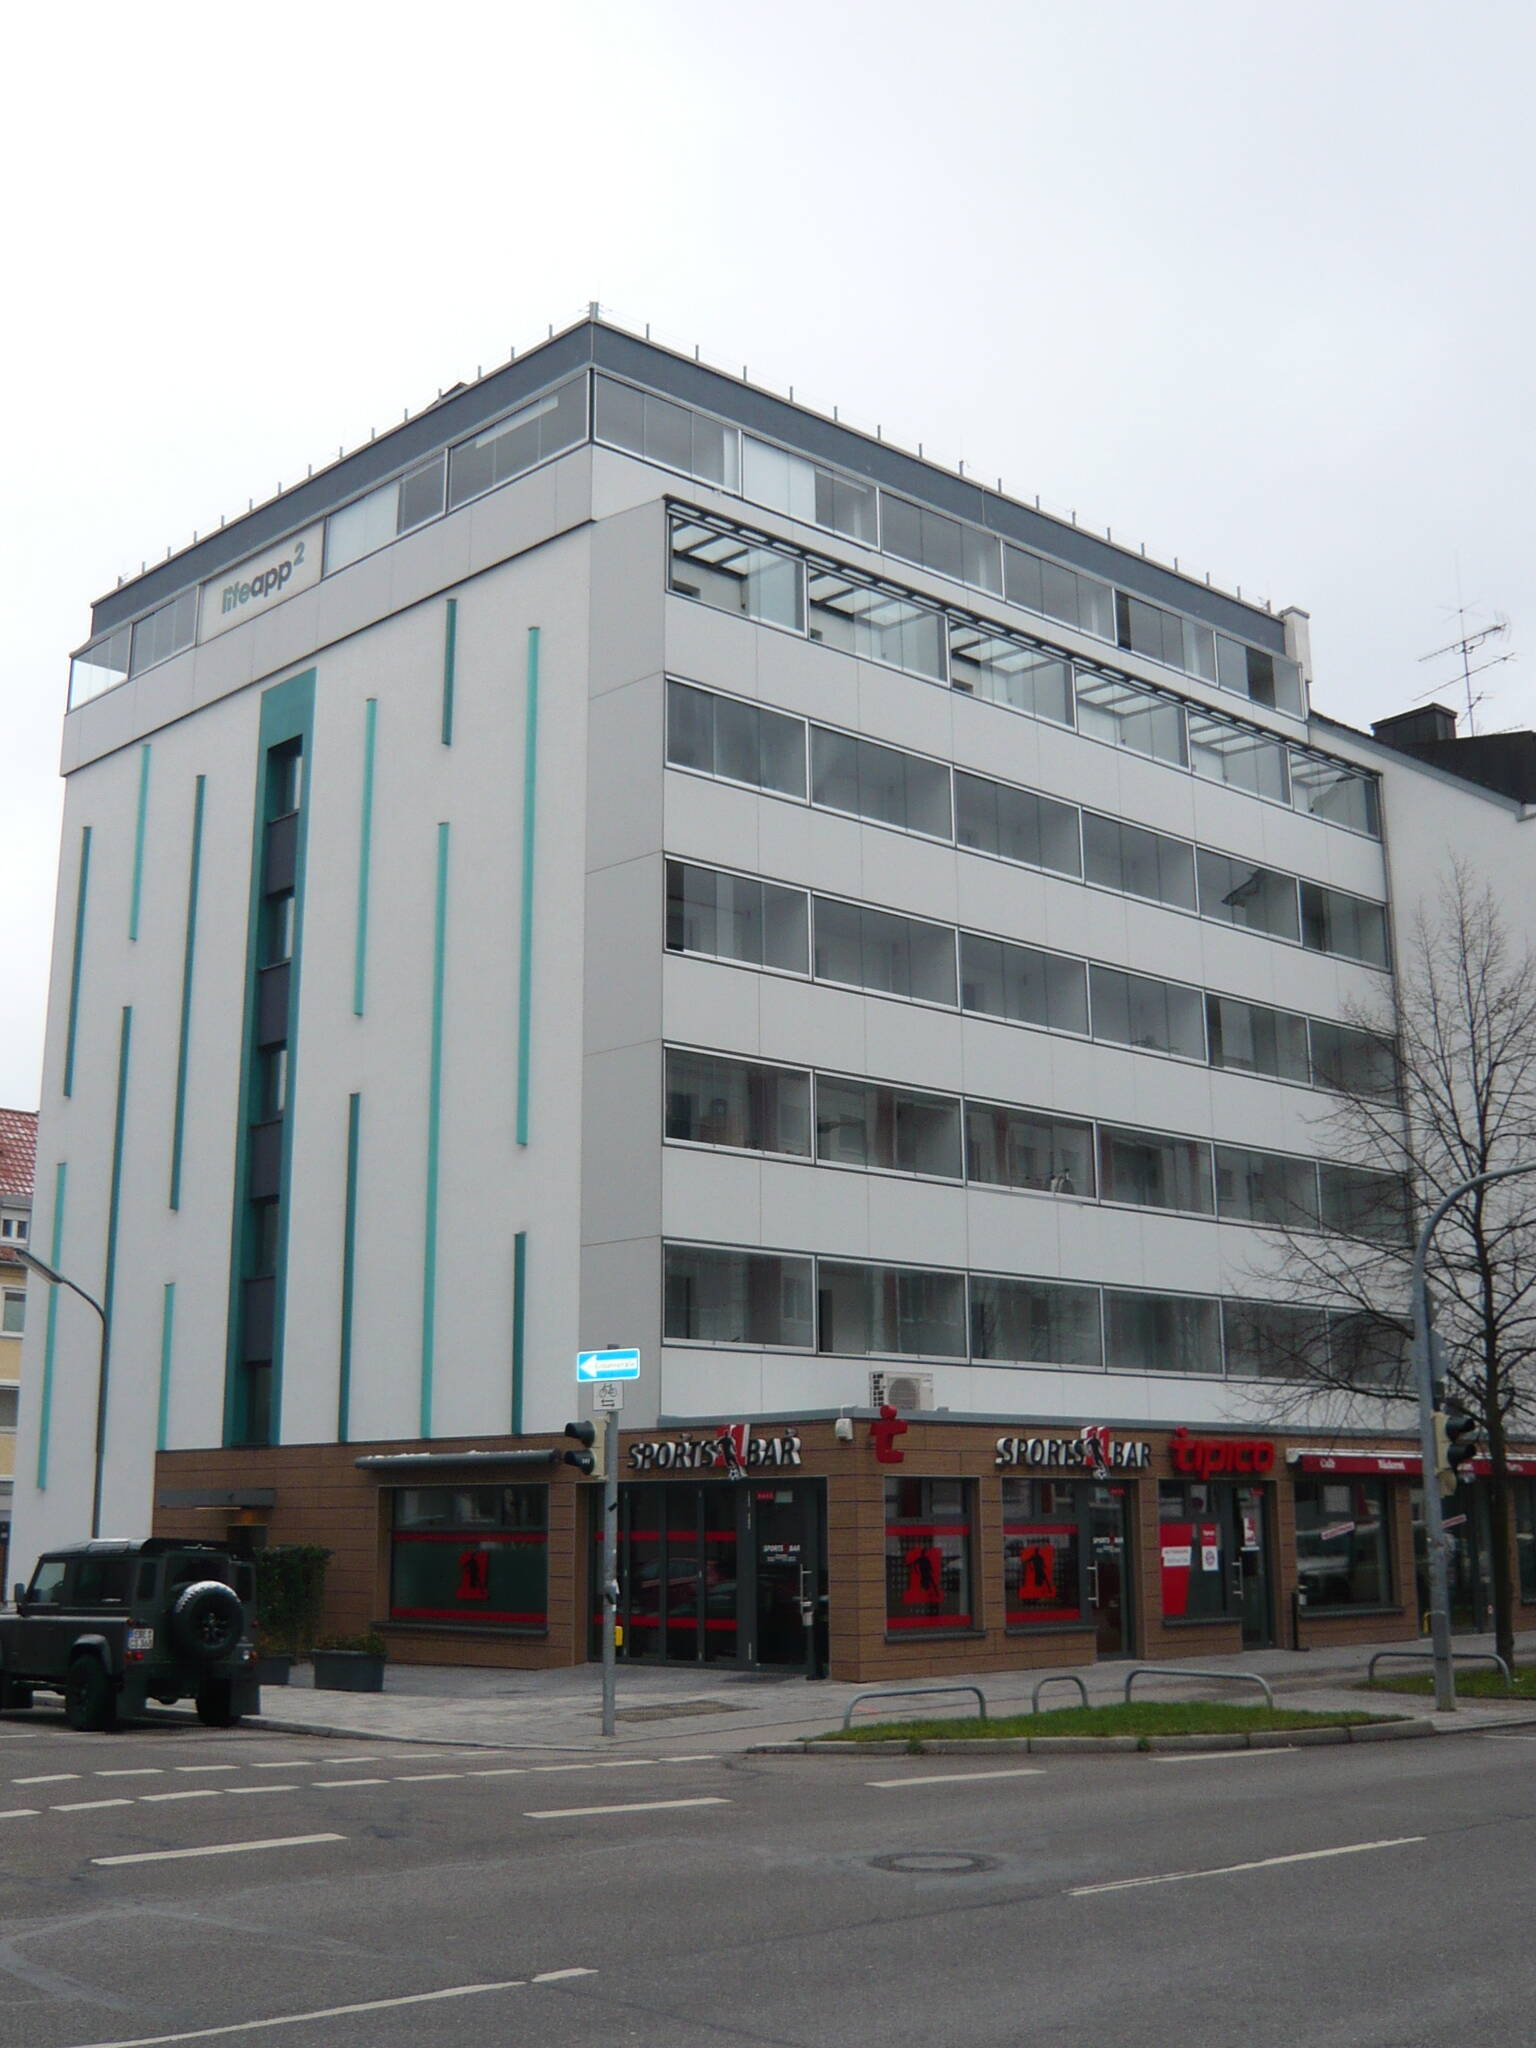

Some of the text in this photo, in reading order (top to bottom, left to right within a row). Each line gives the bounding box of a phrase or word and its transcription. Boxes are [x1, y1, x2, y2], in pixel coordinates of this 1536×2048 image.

[627, 1440, 719, 1470] SPORTS
[749, 1437, 802, 1467] BAR
[995, 1437, 1085, 1467] SPORTS
[1110, 1440, 1152, 1468] BAR
[1167, 1426, 1275, 1480] tipico
